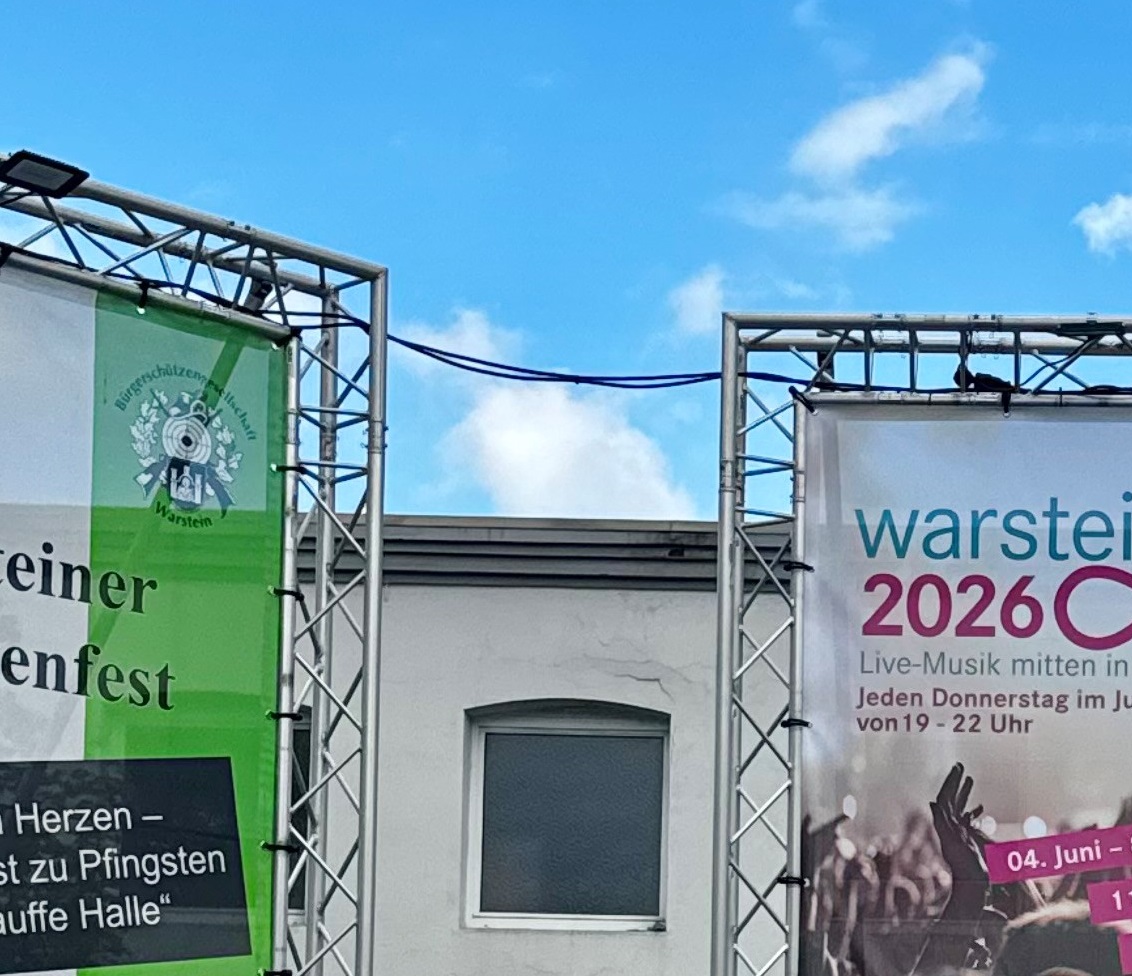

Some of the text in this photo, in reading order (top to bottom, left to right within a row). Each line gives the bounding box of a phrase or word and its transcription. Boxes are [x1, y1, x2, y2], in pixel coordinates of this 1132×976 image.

[155, 501, 213, 528] Warstein
[0, 541, 158, 614] einer
[861, 573, 1044, 639] 2026
[1, 643, 176, 711] enfest
[860, 650, 1001, 677] Live-Musik
[1011, 652, 1096, 677] mitten
[1106, 652, 1128, 677] in
[856, 686, 923, 709] Jeden
[932, 687, 1069, 713] Donnerstag
[1076, 690, 1105, 708] im
[952, 713, 982, 733] 22
[991, 713, 1033, 734] Uhr
[15, 802, 132, 835] Herzen
[29, 858, 68, 884] zu
[79, 846, 226, 885] Pfingsten
[1007, 848, 1047, 872] 04.
[1053, 839, 1102, 870] Juni
